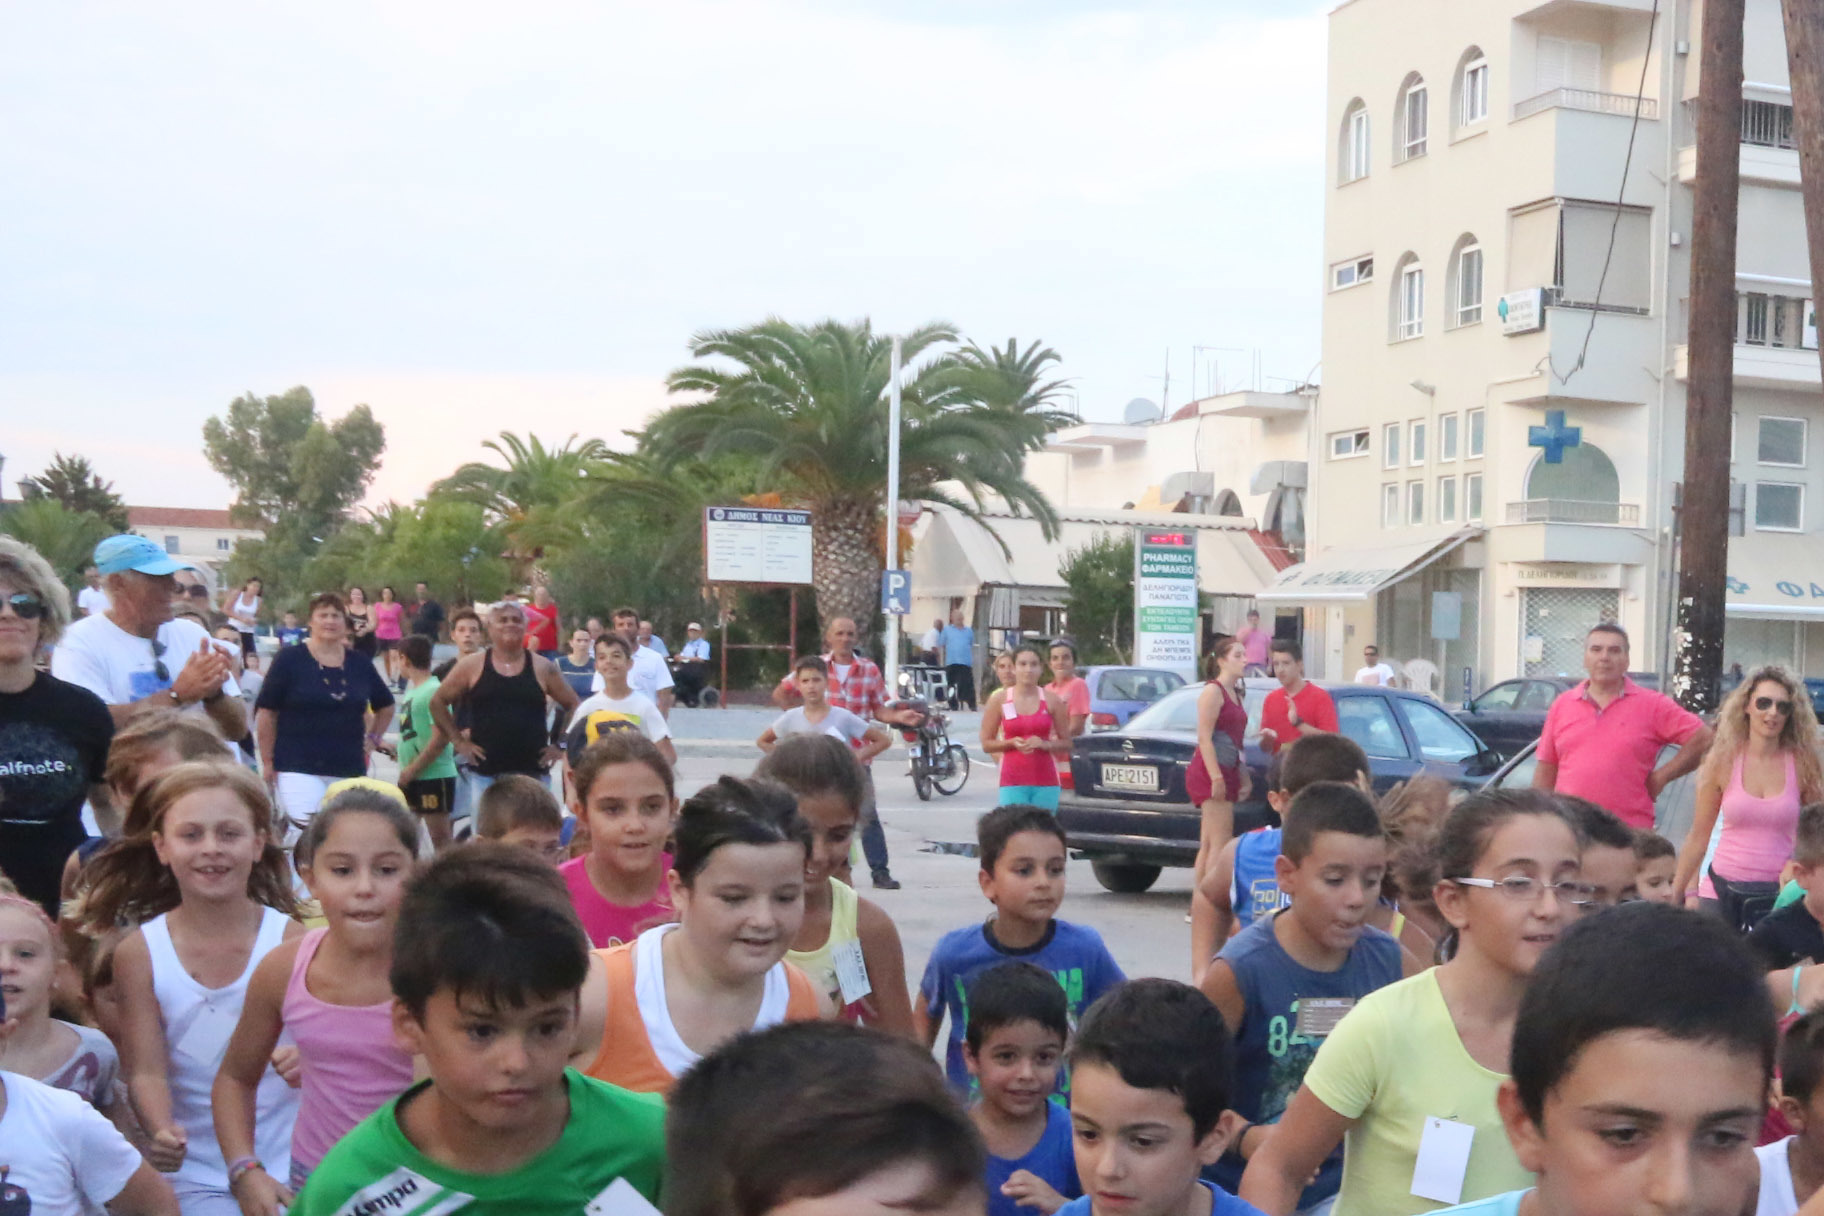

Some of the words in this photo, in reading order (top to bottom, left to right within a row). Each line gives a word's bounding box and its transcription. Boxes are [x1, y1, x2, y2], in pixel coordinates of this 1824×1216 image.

[727, 510, 759, 521] ΔΗΜΟΣ
[761, 512, 784, 523] ΝΕΑΣ
[787, 514, 808, 524] ΚΙΟΥ
[1143, 553, 1193, 563] PHARMACY
[1141, 563, 1194, 575] ΦΑΡΜΑΚΕΙΟ
[889, 573, 906, 596] P
[0, 759, 73, 776] alfnote.
[1129, 768, 1154, 785] 2151
